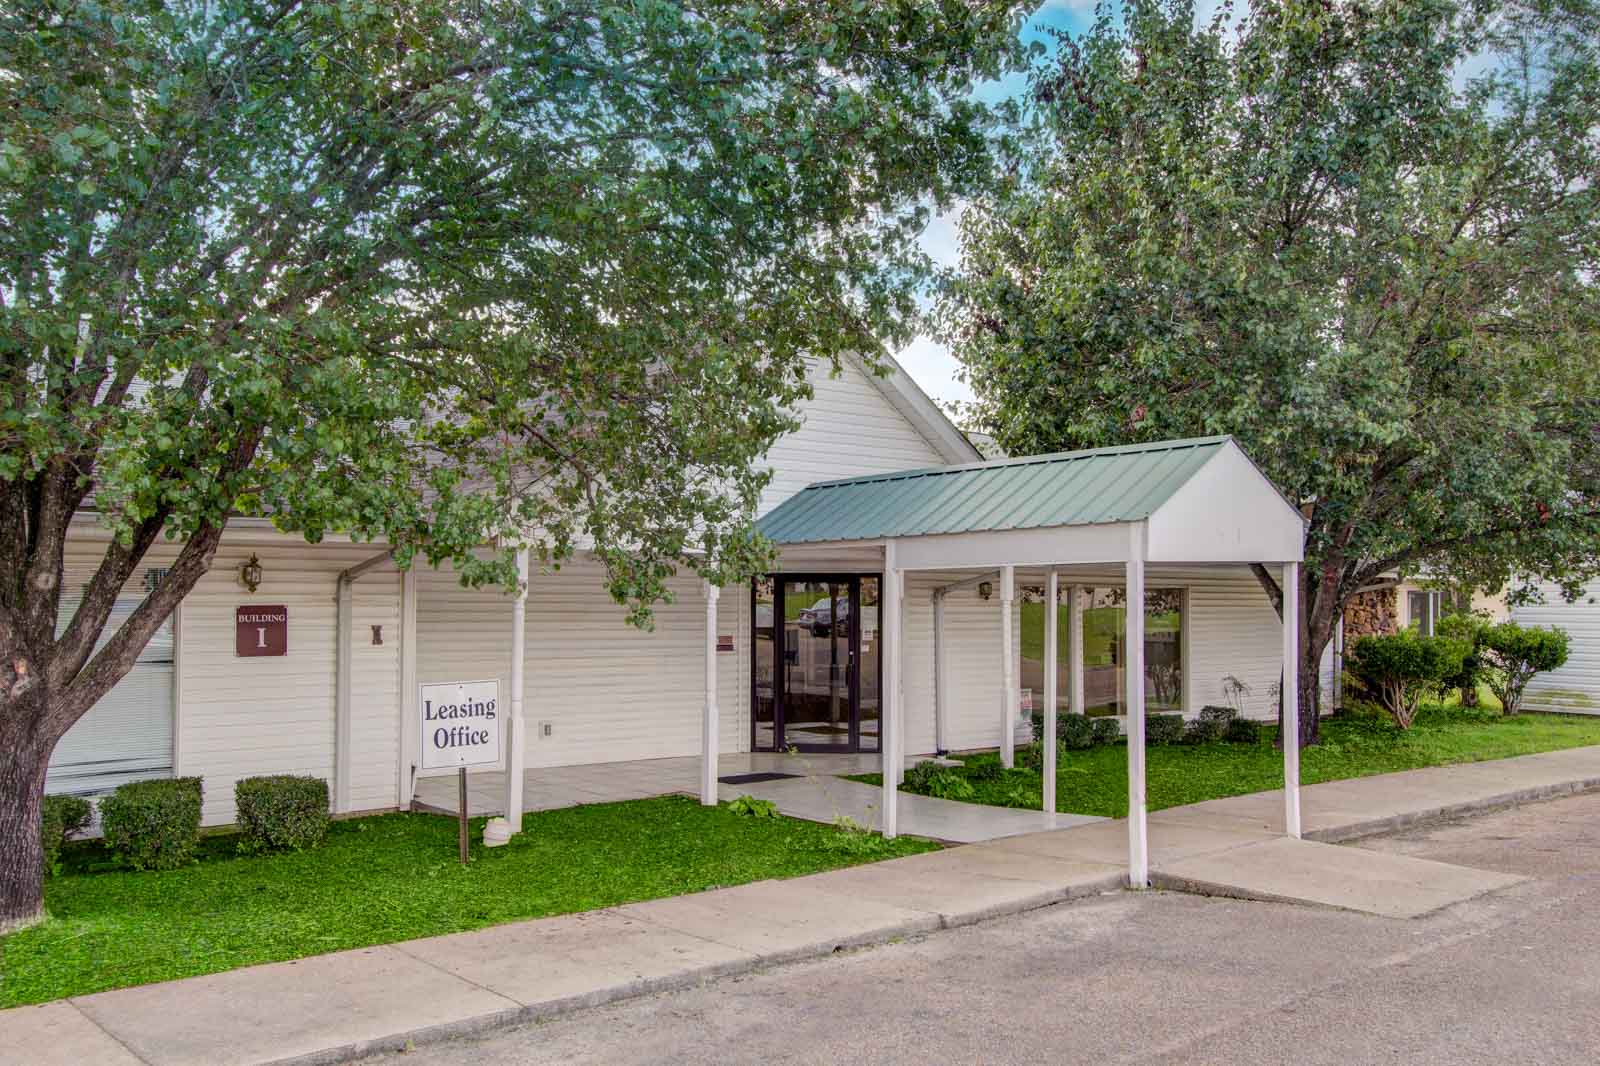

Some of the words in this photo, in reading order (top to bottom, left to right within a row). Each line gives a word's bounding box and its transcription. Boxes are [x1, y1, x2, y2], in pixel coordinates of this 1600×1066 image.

[238, 614, 286, 623] BUILDING
[424, 697, 496, 720] Leasing
[433, 726, 489, 749] Office
